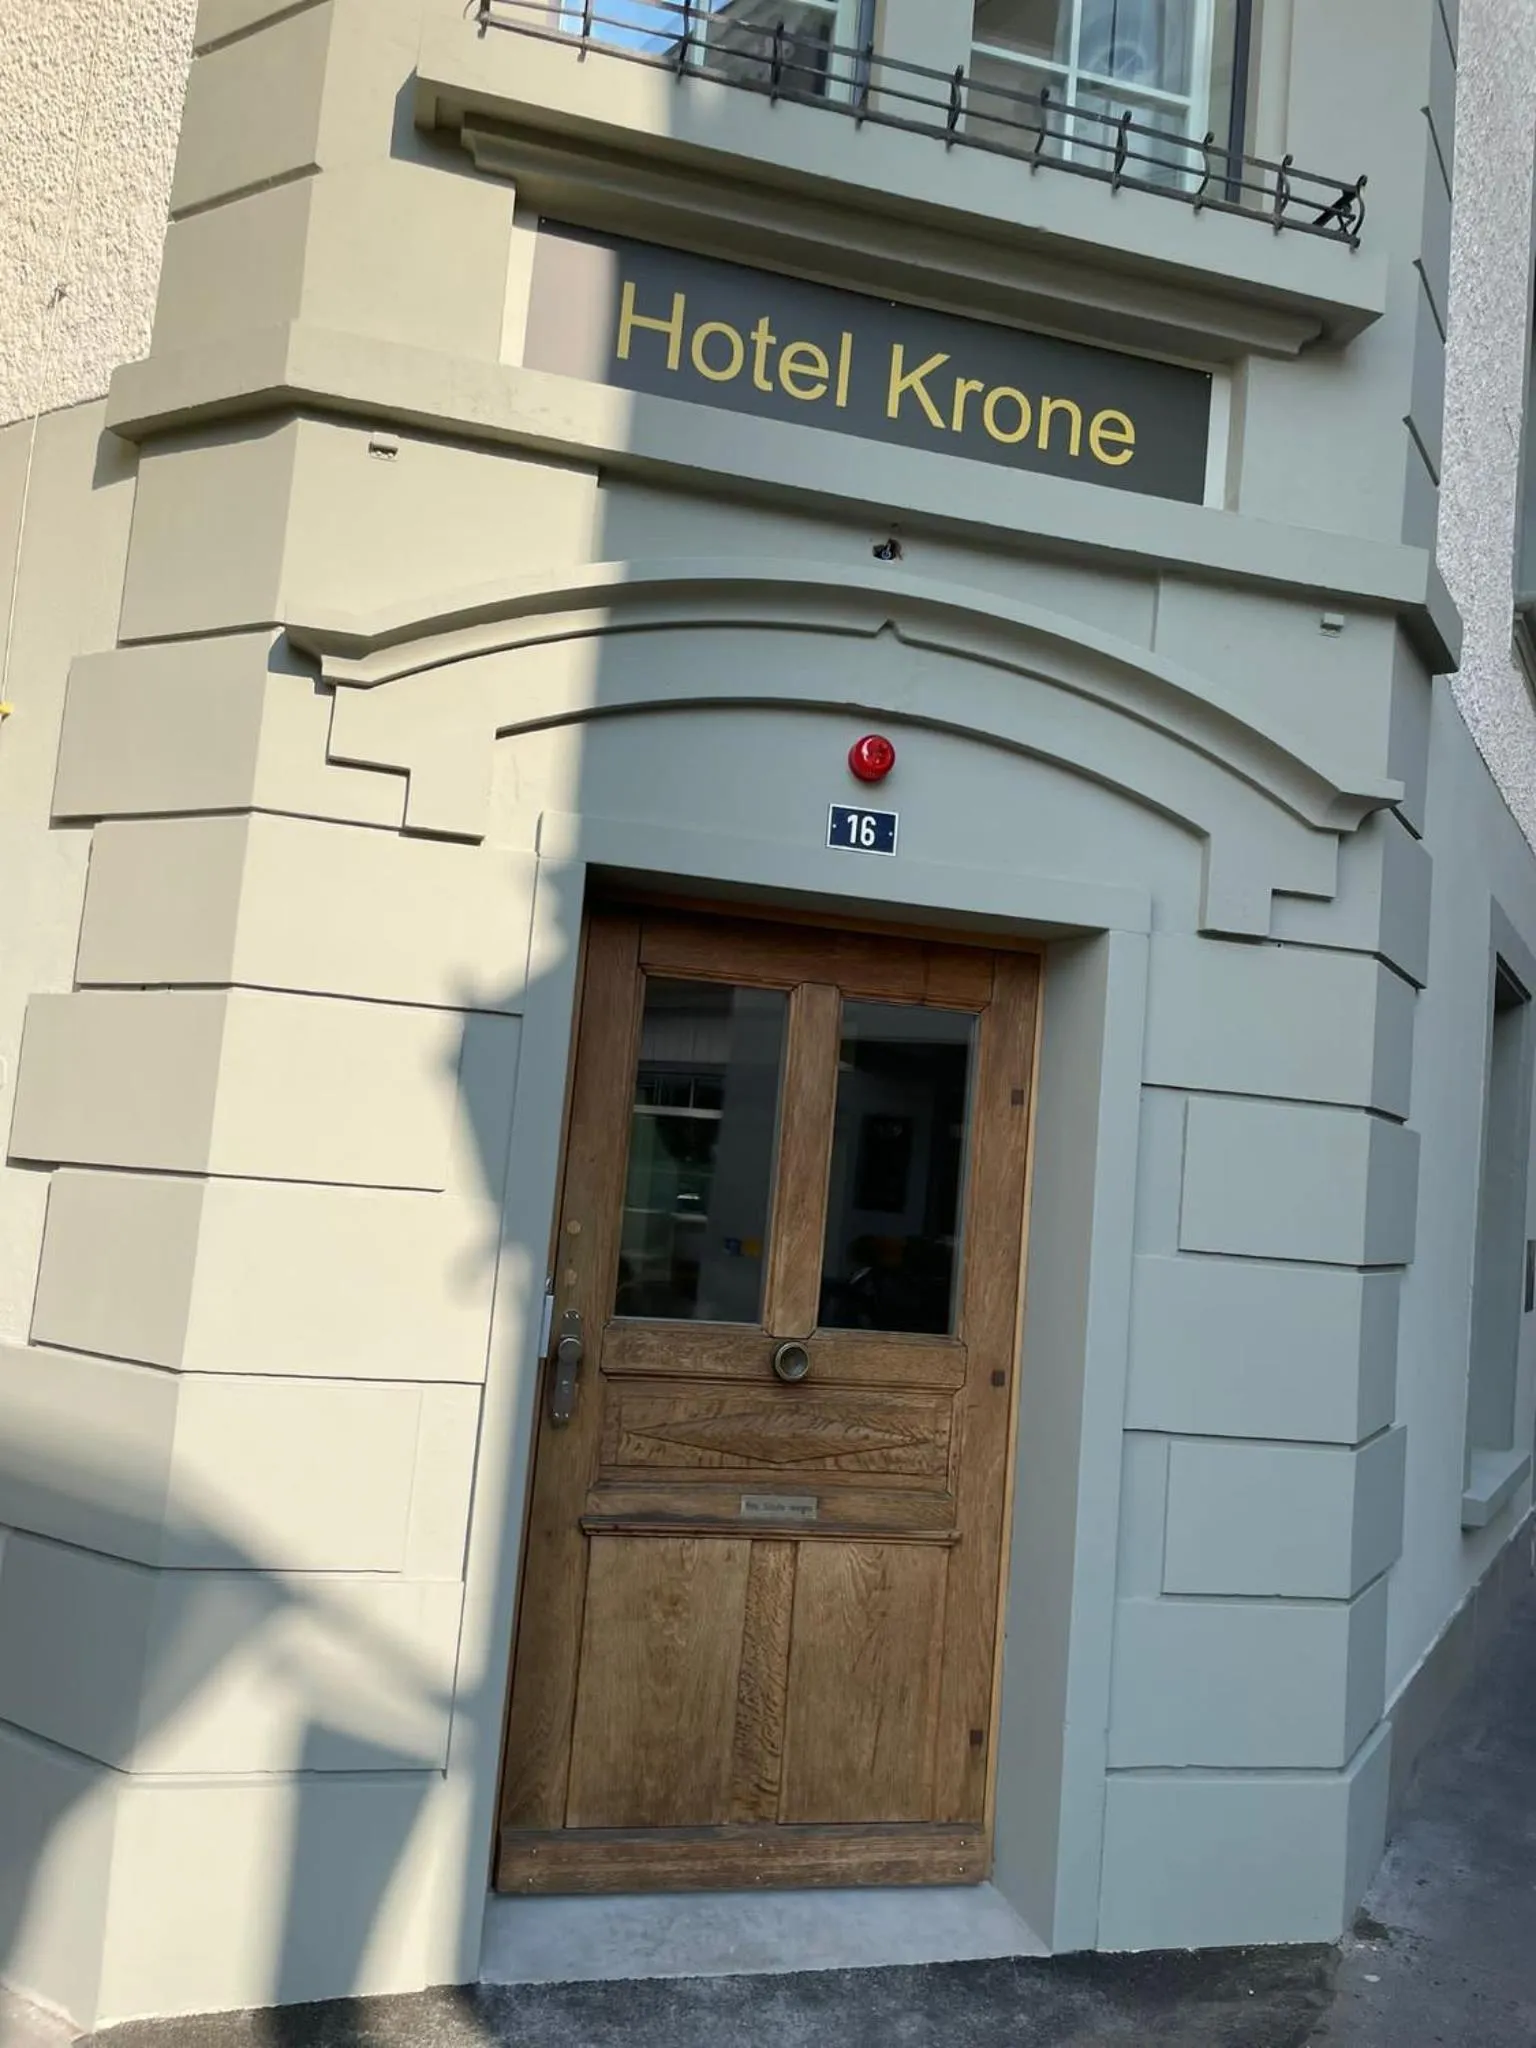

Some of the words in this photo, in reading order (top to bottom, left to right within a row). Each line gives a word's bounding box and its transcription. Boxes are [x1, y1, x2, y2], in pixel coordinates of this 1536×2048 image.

[617, 281, 853, 408] Hotel
[887, 343, 1136, 466] Krone
[847, 814, 877, 846] 16
